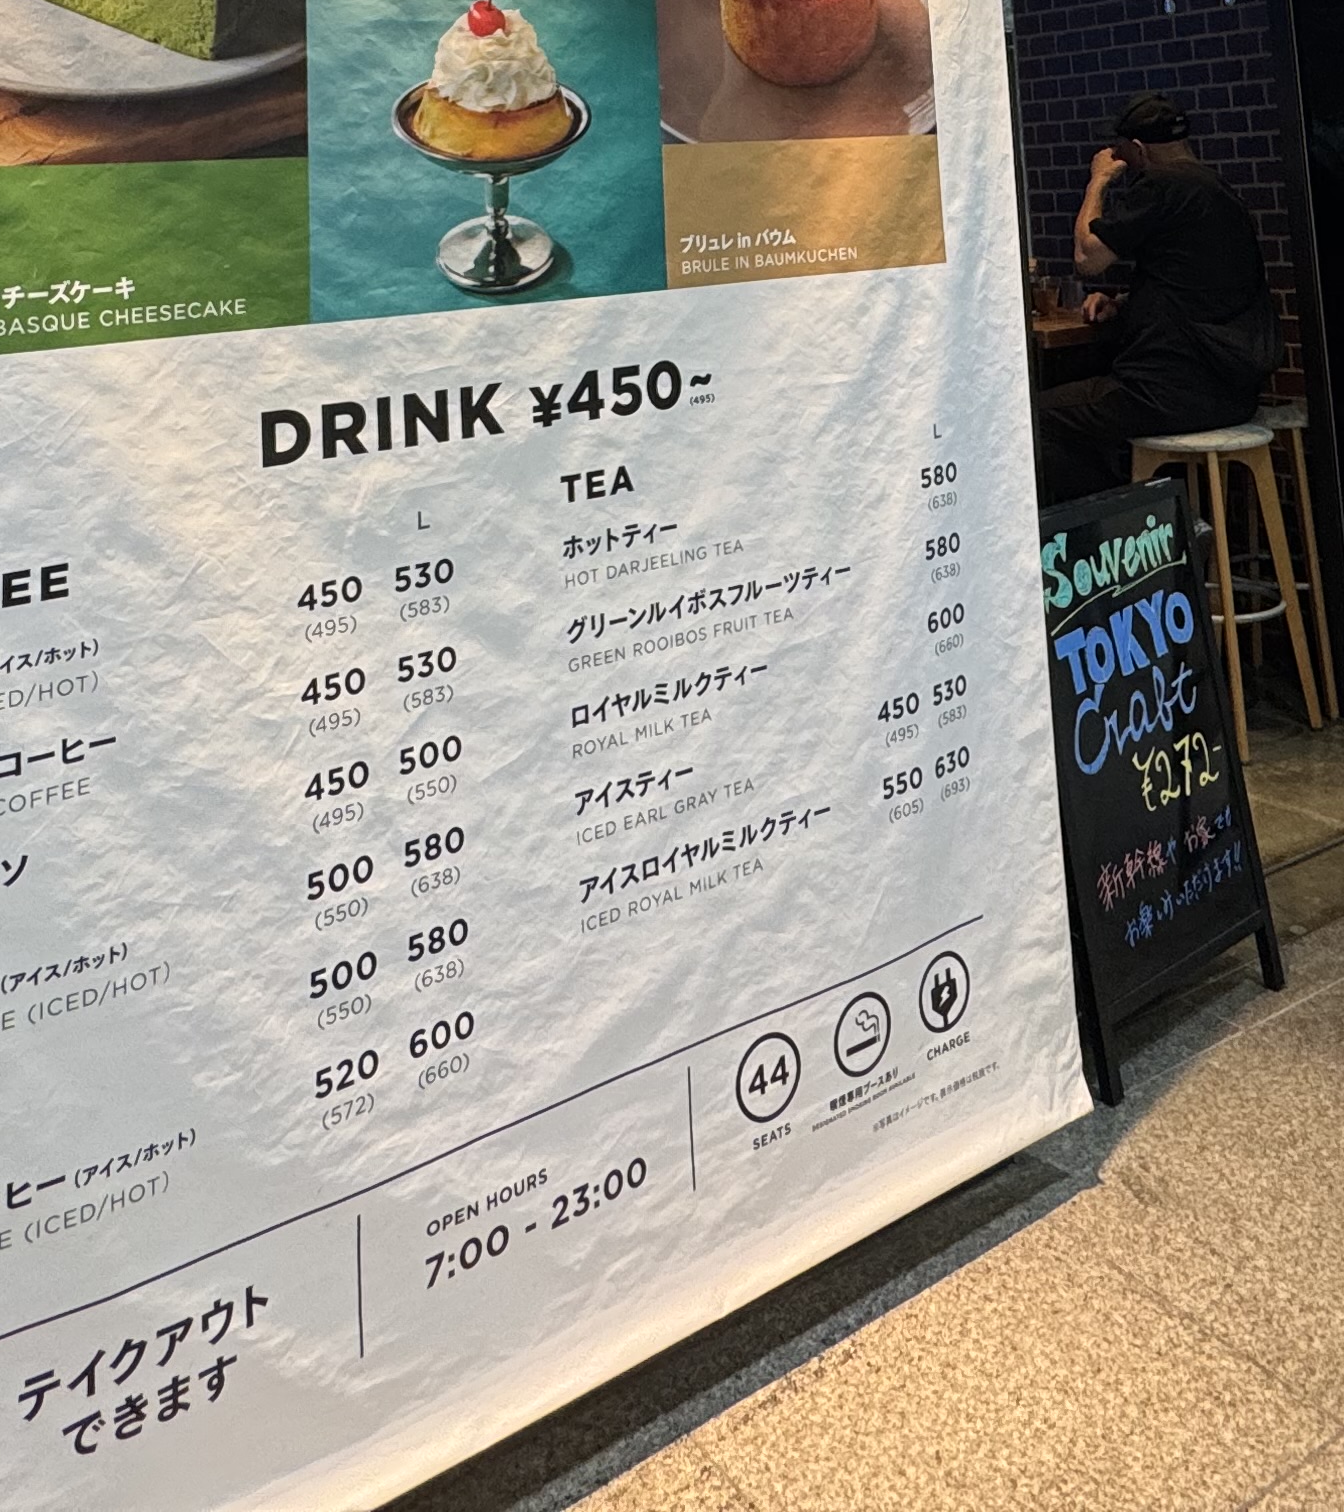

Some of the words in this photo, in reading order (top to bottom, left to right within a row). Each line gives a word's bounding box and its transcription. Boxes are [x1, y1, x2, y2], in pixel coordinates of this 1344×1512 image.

[680, 234, 733, 253] ブリュレ
[737, 232, 751, 249] in
[755, 228, 797, 247] バウム
[682, 257, 729, 275] BRULE
[735, 256, 749, 270] IN
[755, 246, 858, 268] BAUMKUCHEN
[100, 298, 247, 329] CHEESECAKE
[260, 382, 505, 468] DRINK
[688, 393, 716, 407] (495)
[933, 423, 942, 439] L
[561, 465, 634, 502] TEA
[921, 461, 957, 489] 580
[928, 492, 957, 511] (638)
[417, 512, 430, 530] L
[563, 522, 678, 560] ホットティー
[925, 532, 961, 561] 580
[297, 575, 363, 612] 450
[394, 557, 455, 593] 530
[565, 569, 599, 588] HOT
[607, 546, 708, 580] DARJEELING
[715, 539, 744, 557] TEA
[1041, 514, 1173, 612] Souvenir
[303, 615, 358, 643] (495)
[399, 595, 451, 623] (583)
[566, 565, 852, 644] グリーンルイボスフルーツティー
[927, 603, 965, 634] 600
[568, 646, 626, 673] GREEN
[634, 627, 708, 657] ROOIBOS
[713, 615, 757, 639] FRUIT
[764, 607, 794, 626] TEA
[1055, 589, 1195, 695] TOKYO
[301, 667, 366, 707] 450
[397, 646, 458, 683] 530
[571, 664, 768, 728] ロイヤルミルクティー
[877, 692, 920, 724] 450
[932, 674, 967, 708] 530
[571, 730, 629, 759] ROYAL
[635, 719, 675, 744] MILK
[681, 708, 712, 729] TEA
[885, 724, 920, 748] (495)
[937, 704, 967, 729] (583)
[303, 760, 370, 802] 450
[399, 735, 463, 776] 500
[574, 766, 695, 816] アイスティー
[882, 766, 923, 801] 550
[935, 745, 971, 780] 630
[576, 820, 616, 846] ICED
[623, 806, 668, 831] EARL
[674, 789, 718, 816] GRAY
[724, 777, 755, 799] TEA
[888, 797, 924, 824] (605)
[940, 776, 971, 802] (693)
[306, 855, 374, 901] 500
[404, 826, 465, 868] 580
[579, 806, 832, 904] アイスロイヤルミルクティー
[580, 907, 621, 934] ICED
[627, 887, 683, 919] ROYAL
[689, 871, 728, 896] MILK
[733, 857, 764, 879] TEA
[0, 942, 128, 995] (アイス/ホット)
[309, 951, 378, 999] 500
[407, 918, 469, 963] 580
[28, 960, 171, 1027] (ICED/HOT)
[314, 1049, 380, 1099] 520
[409, 1010, 475, 1059] 600
[925, 1030, 972, 1061] CHARGE
[321, 1092, 375, 1131] (572)
[417, 1053, 470, 1090] (660)
[748, 1054, 789, 1095] 44
[74, 1127, 197, 1188] (アイス/ホット)
[753, 1122, 792, 1150] SEATS
[24, 1170, 170, 1245] (ICED/HOT)
[425, 1224, 509, 1289] 7:00
[551, 1157, 647, 1230] 23:00
[426, 1198, 481, 1238] OPEN
[486, 1168, 549, 1215] HOURS
[19, 1285, 269, 1421] テイクアウト
[62, 1355, 237, 1455] できます
